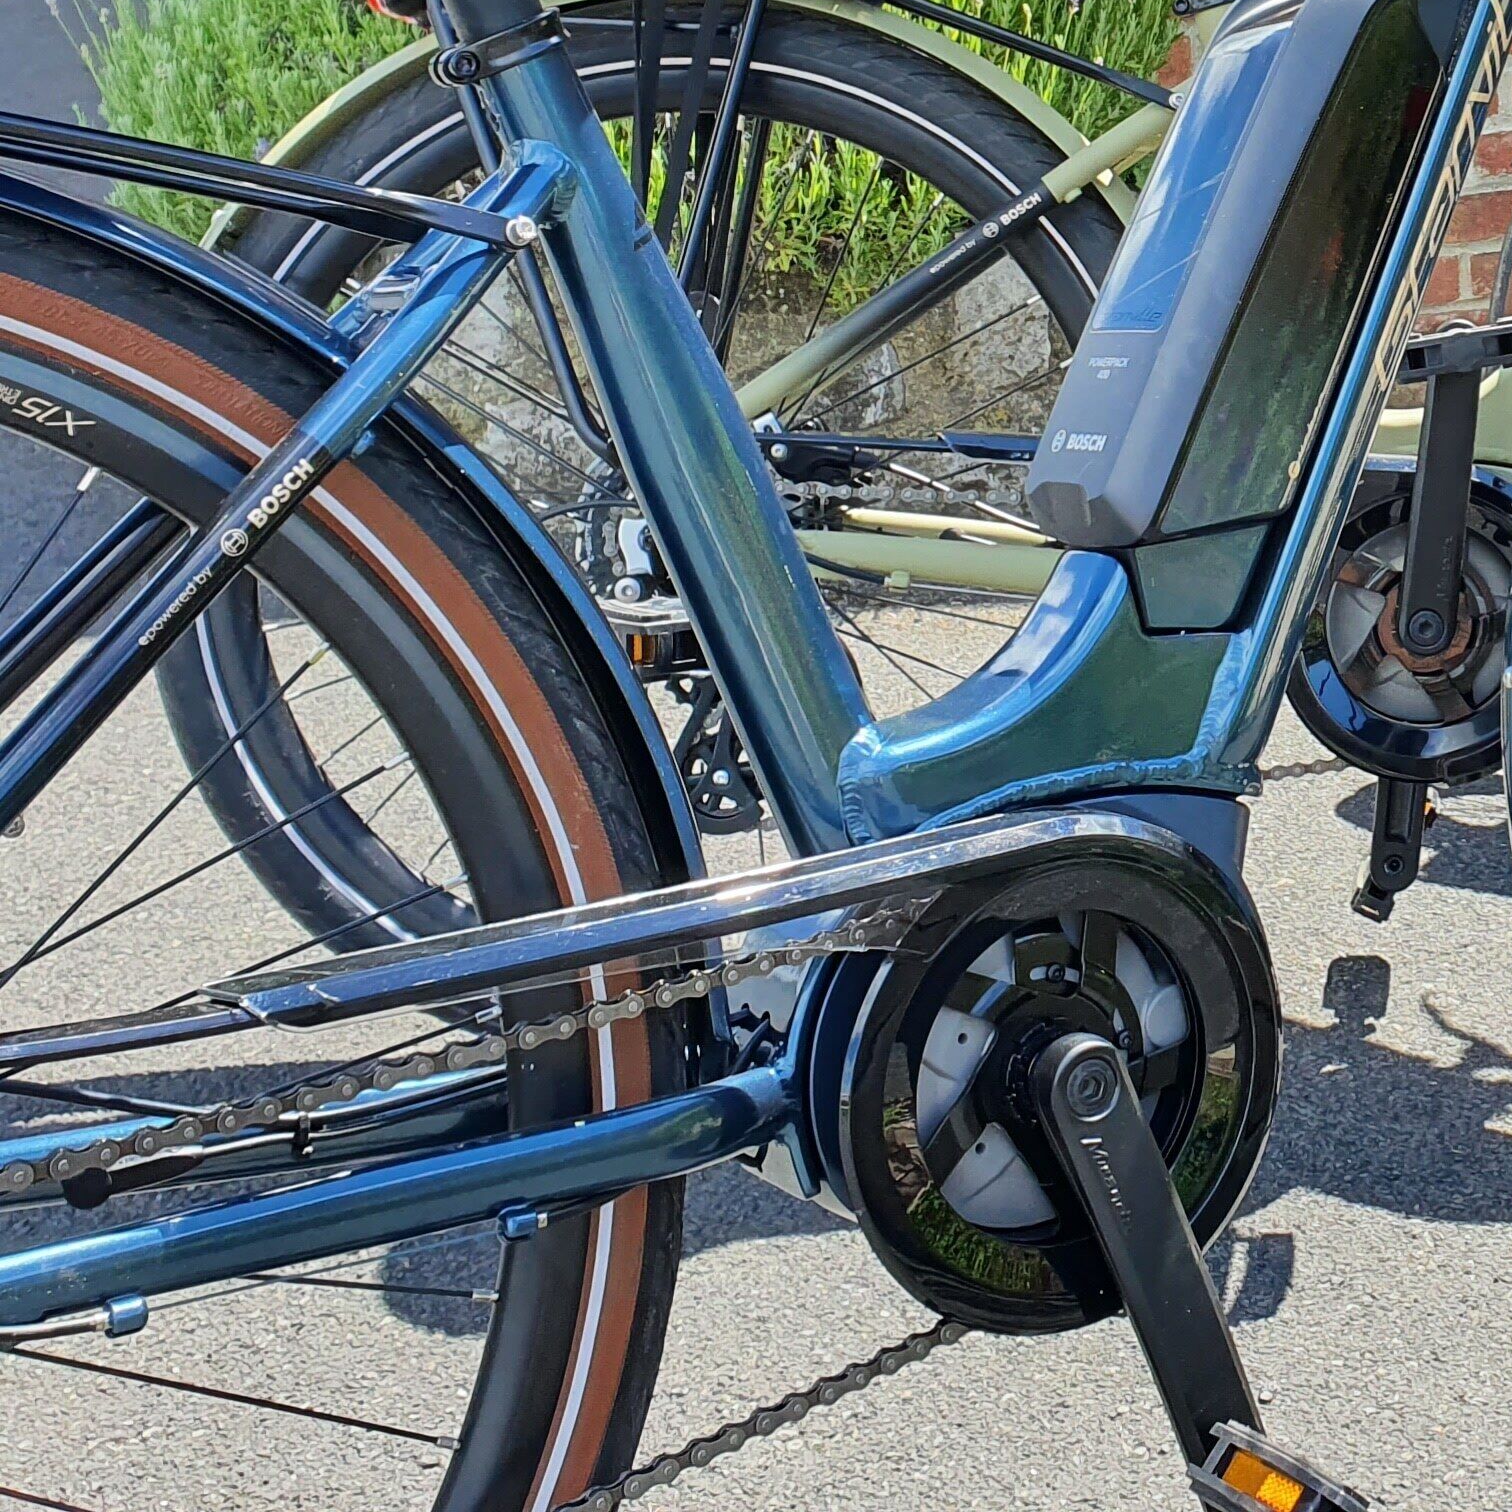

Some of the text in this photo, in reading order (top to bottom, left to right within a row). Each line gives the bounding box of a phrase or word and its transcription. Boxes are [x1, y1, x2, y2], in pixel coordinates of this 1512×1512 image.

[999, 192, 1042, 226] BOSCH
[11, 396, 97, 437] X15
[1066, 434, 1107, 452] BOSCH
[247, 459, 315, 529] BOSCH
[138, 566, 214, 647] epowered by
